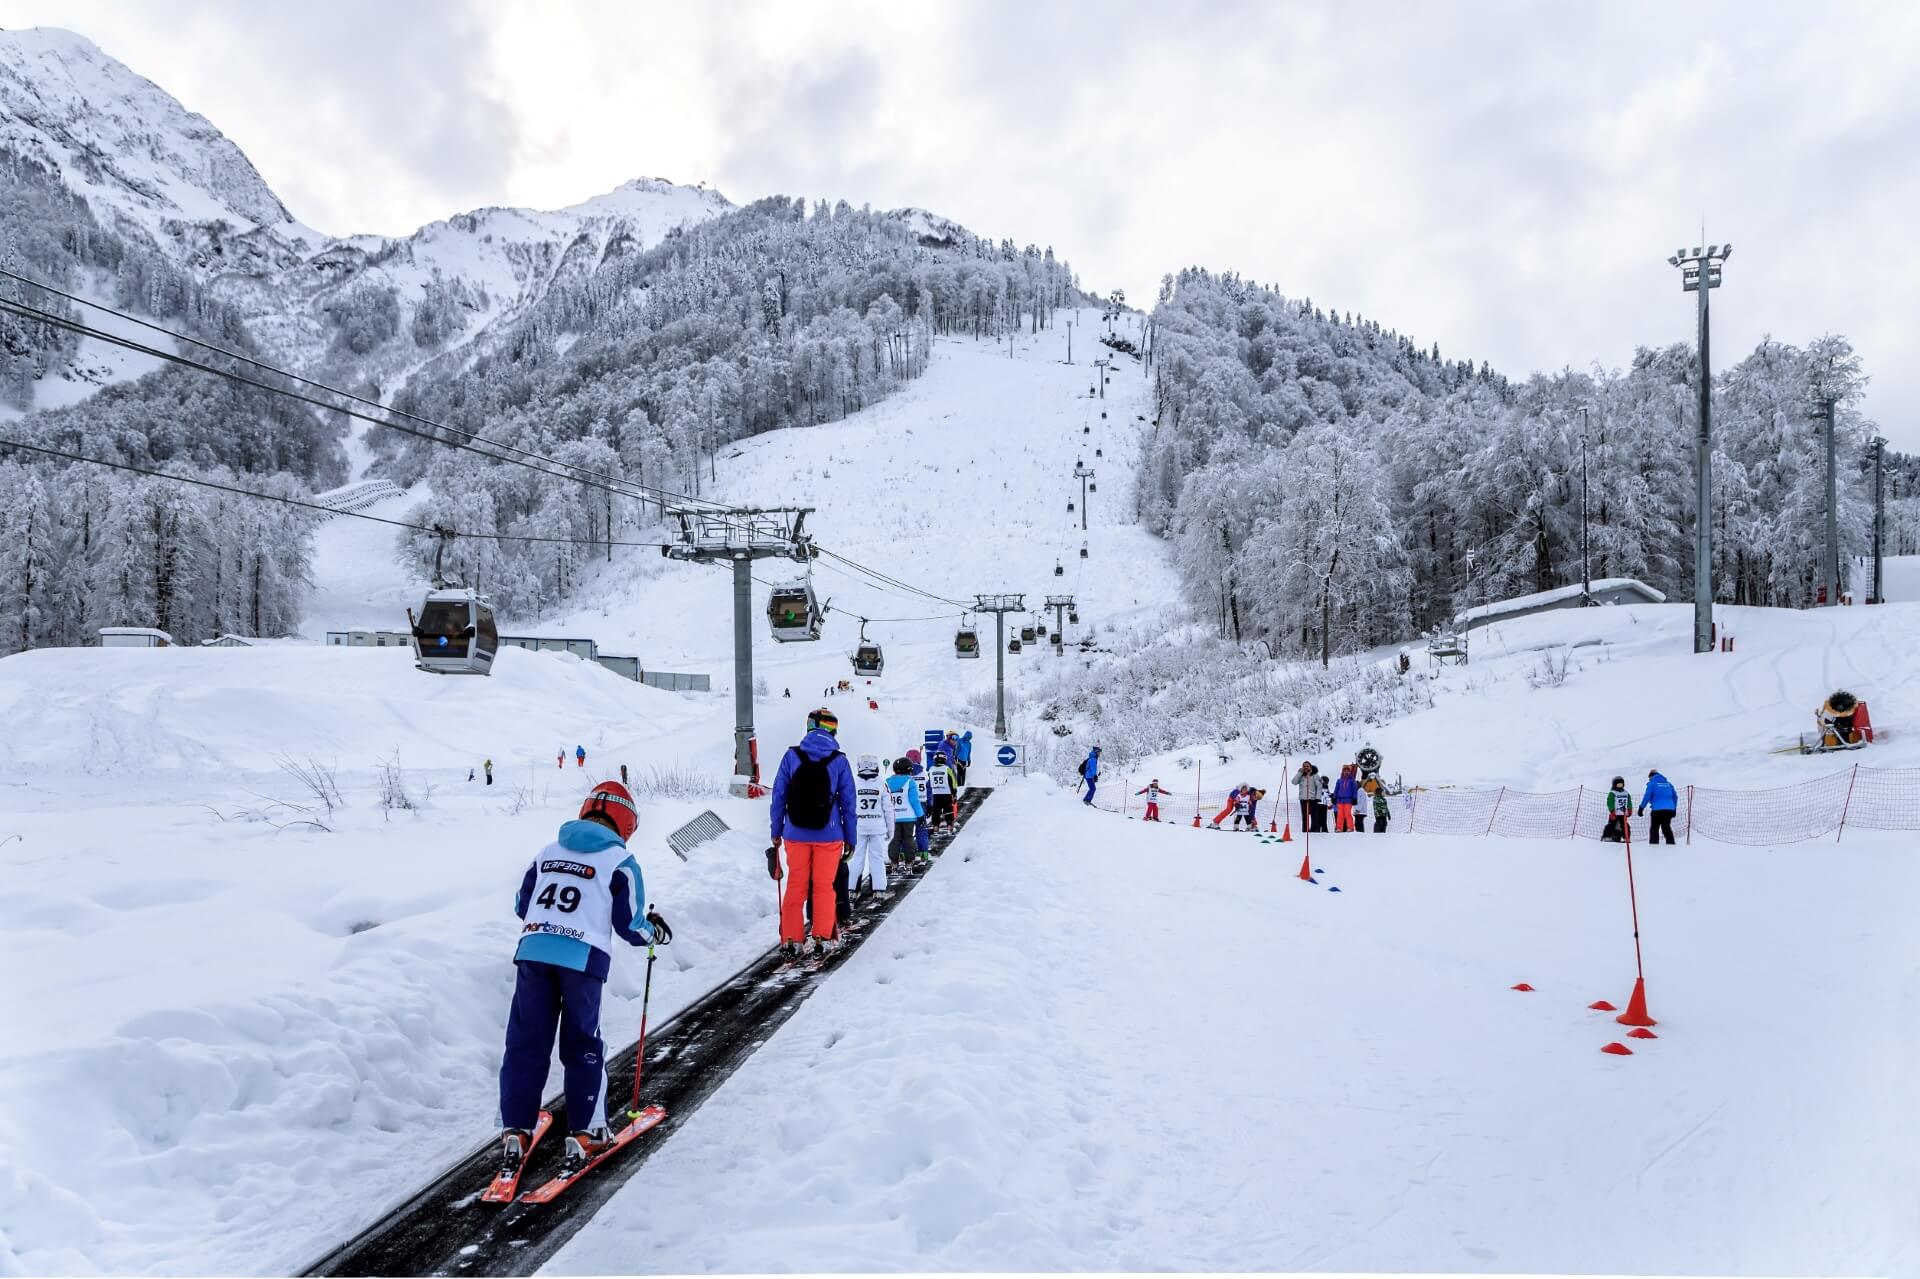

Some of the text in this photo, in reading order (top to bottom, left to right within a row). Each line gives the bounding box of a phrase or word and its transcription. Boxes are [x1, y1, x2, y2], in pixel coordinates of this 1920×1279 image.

[934, 776, 944, 784] 55
[860, 799, 877, 809] 37
[536, 883, 582, 913] 49
